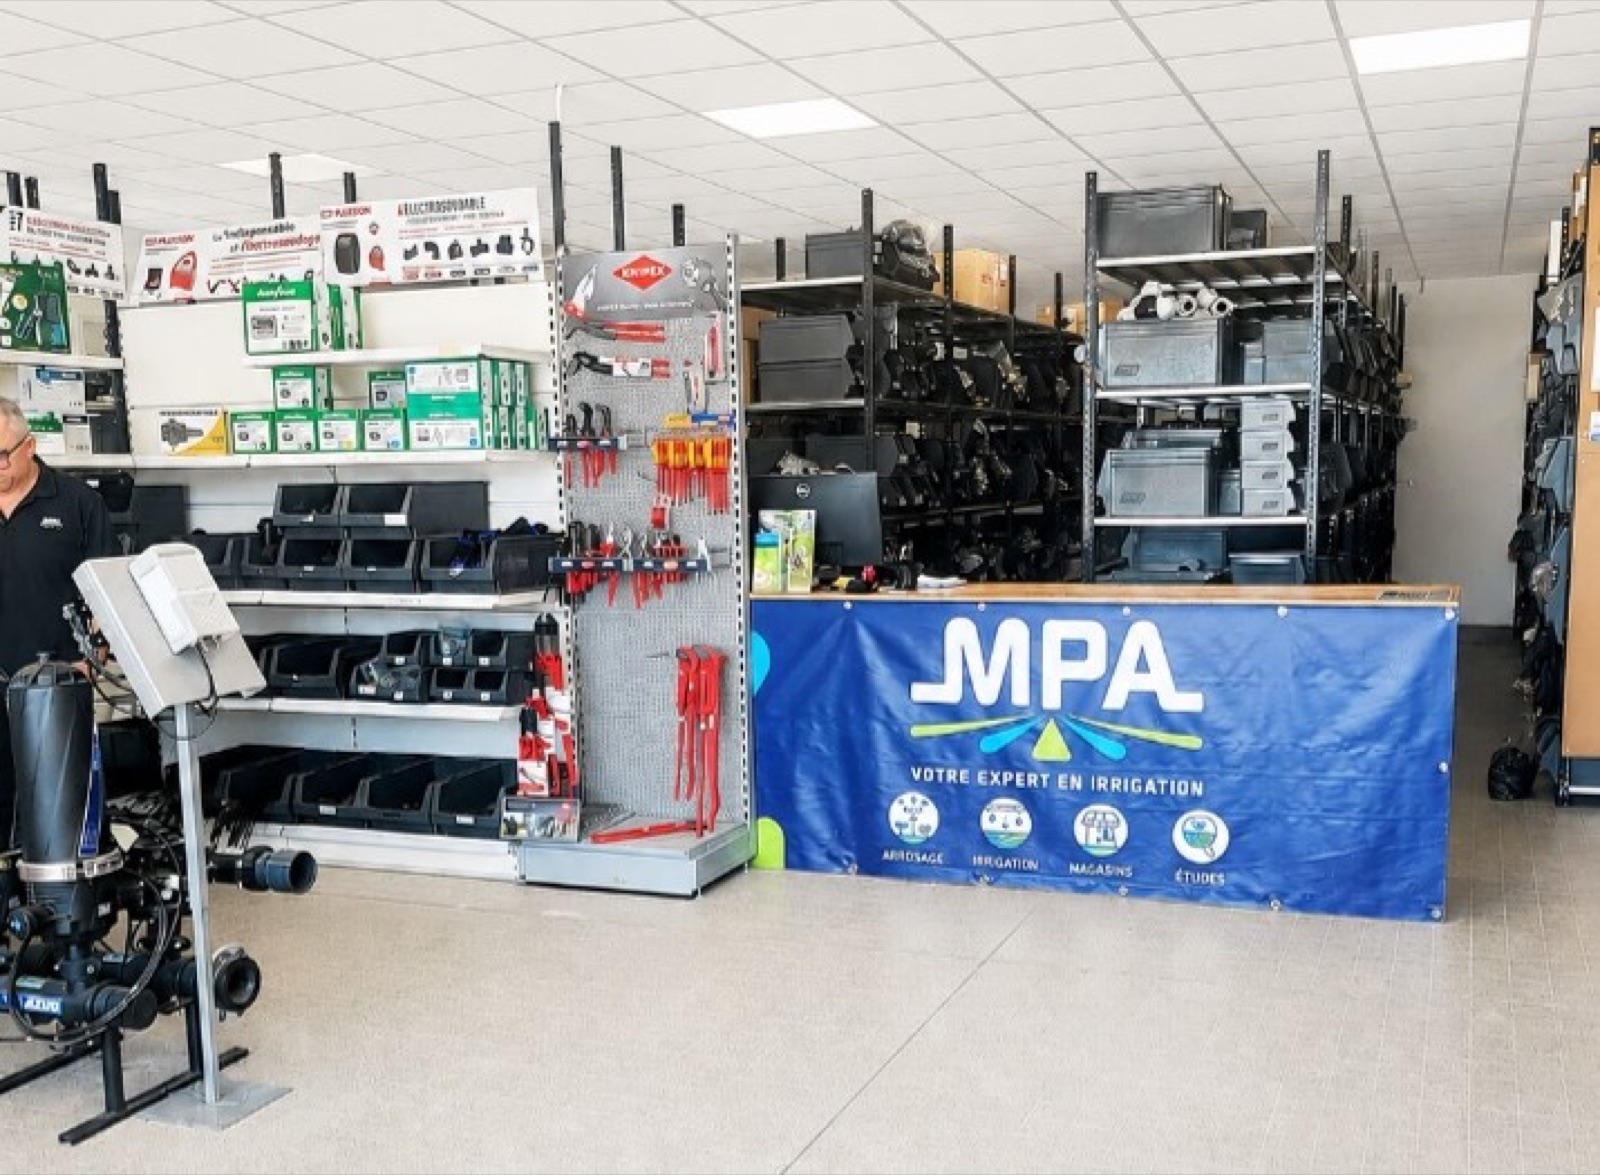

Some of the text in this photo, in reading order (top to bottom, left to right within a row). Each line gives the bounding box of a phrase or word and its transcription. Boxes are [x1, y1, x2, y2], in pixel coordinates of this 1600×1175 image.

[910, 617, 1203, 712] MPA
[910, 767, 1204, 797] VOTRE EXPERT EN IRRIGATION
[882, 849, 945, 865] ARROSAGE
[972, 855, 1039, 870] IRRIGATION
[1069, 862, 1133, 878] MAGASINS
[1175, 867, 1225, 885] ÉTUDES
